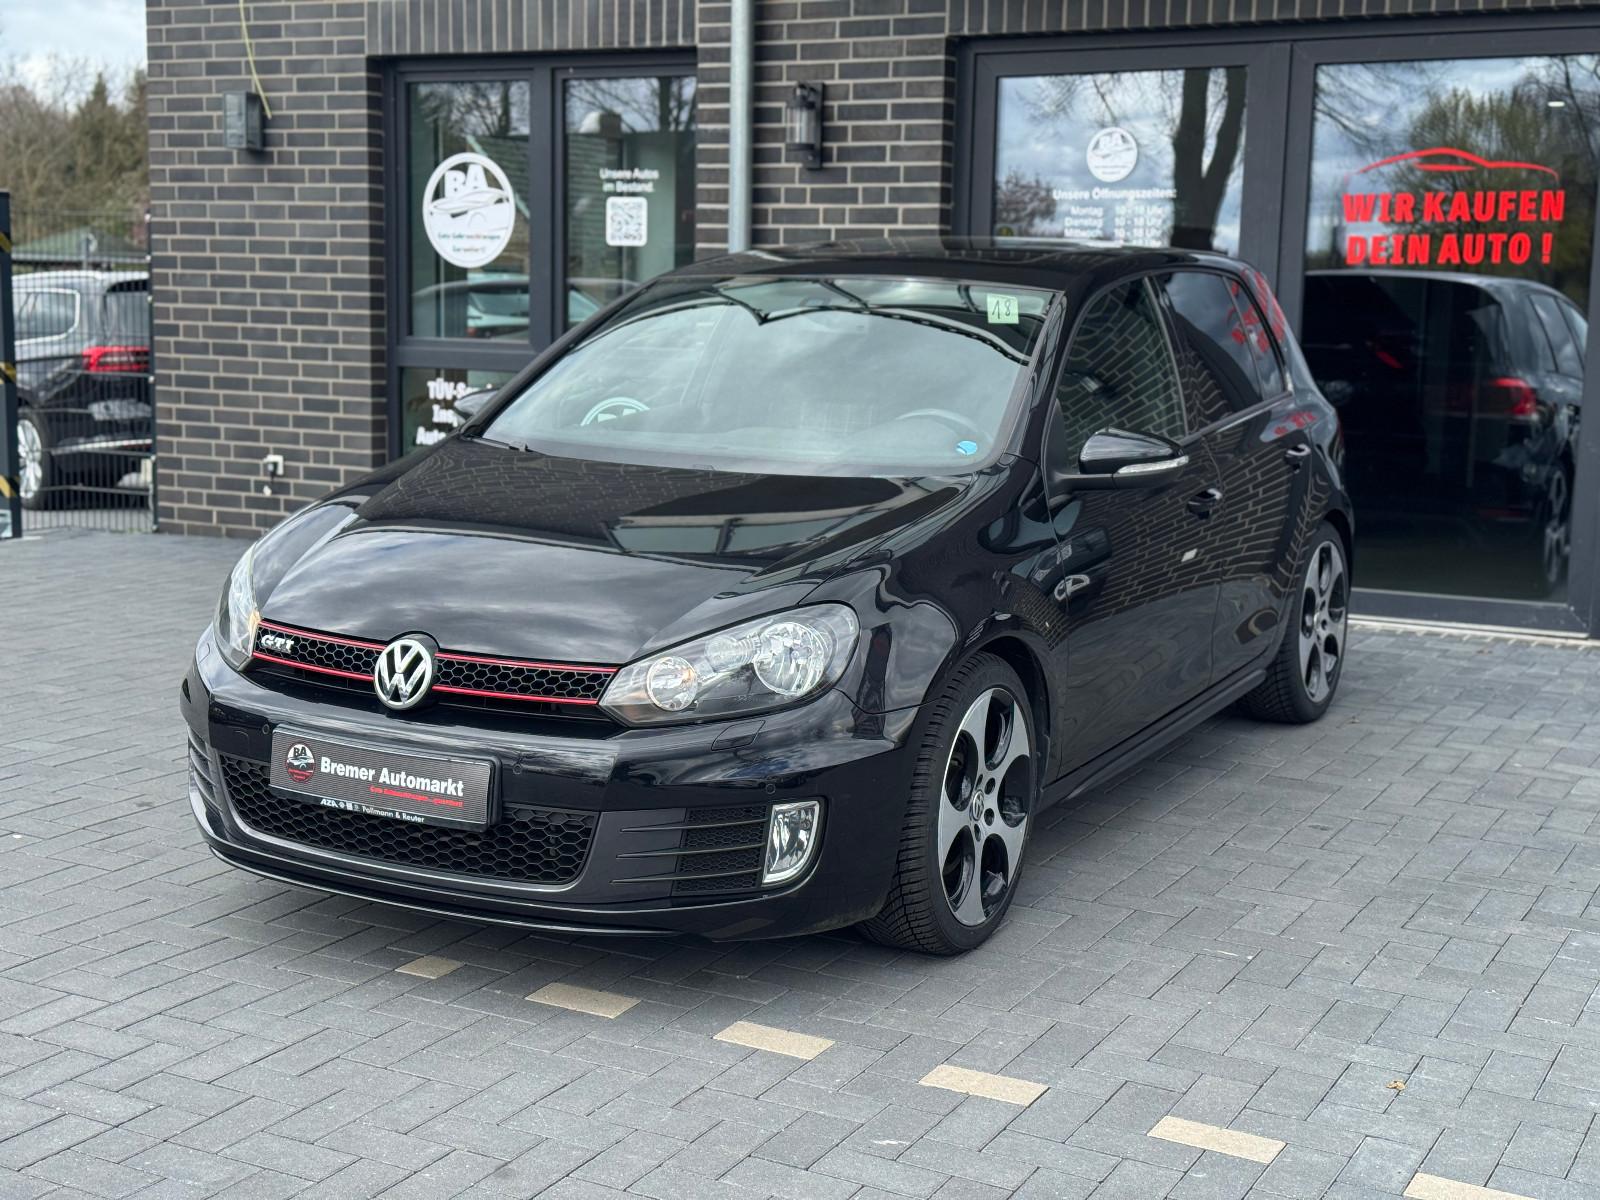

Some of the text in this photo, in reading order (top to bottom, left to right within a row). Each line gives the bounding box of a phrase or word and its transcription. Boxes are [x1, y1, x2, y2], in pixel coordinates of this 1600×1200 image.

[444, 163, 488, 198] BA
[600, 168, 659, 179] Unsere Autos
[603, 181, 614, 192] im
[1053, 187, 1177, 202] Unsere Öffnungszeiten:
[1071, 206, 1103, 217] Montag
[1342, 190, 1565, 223] WIR KAUFEN
[1146, 216, 1162, 226] Uhr
[1346, 234, 1430, 265] DEIN
[1437, 233, 1531, 265] AUTO
[992, 298, 1011, 319] 18
[261, 635, 295, 654] GTI
[293, 746, 307, 758] BA
[320, 757, 375, 782] Bremer
[379, 767, 464, 797] Automarkt
[395, 811, 401, 819] &
[402, 812, 425, 823] Reuter
